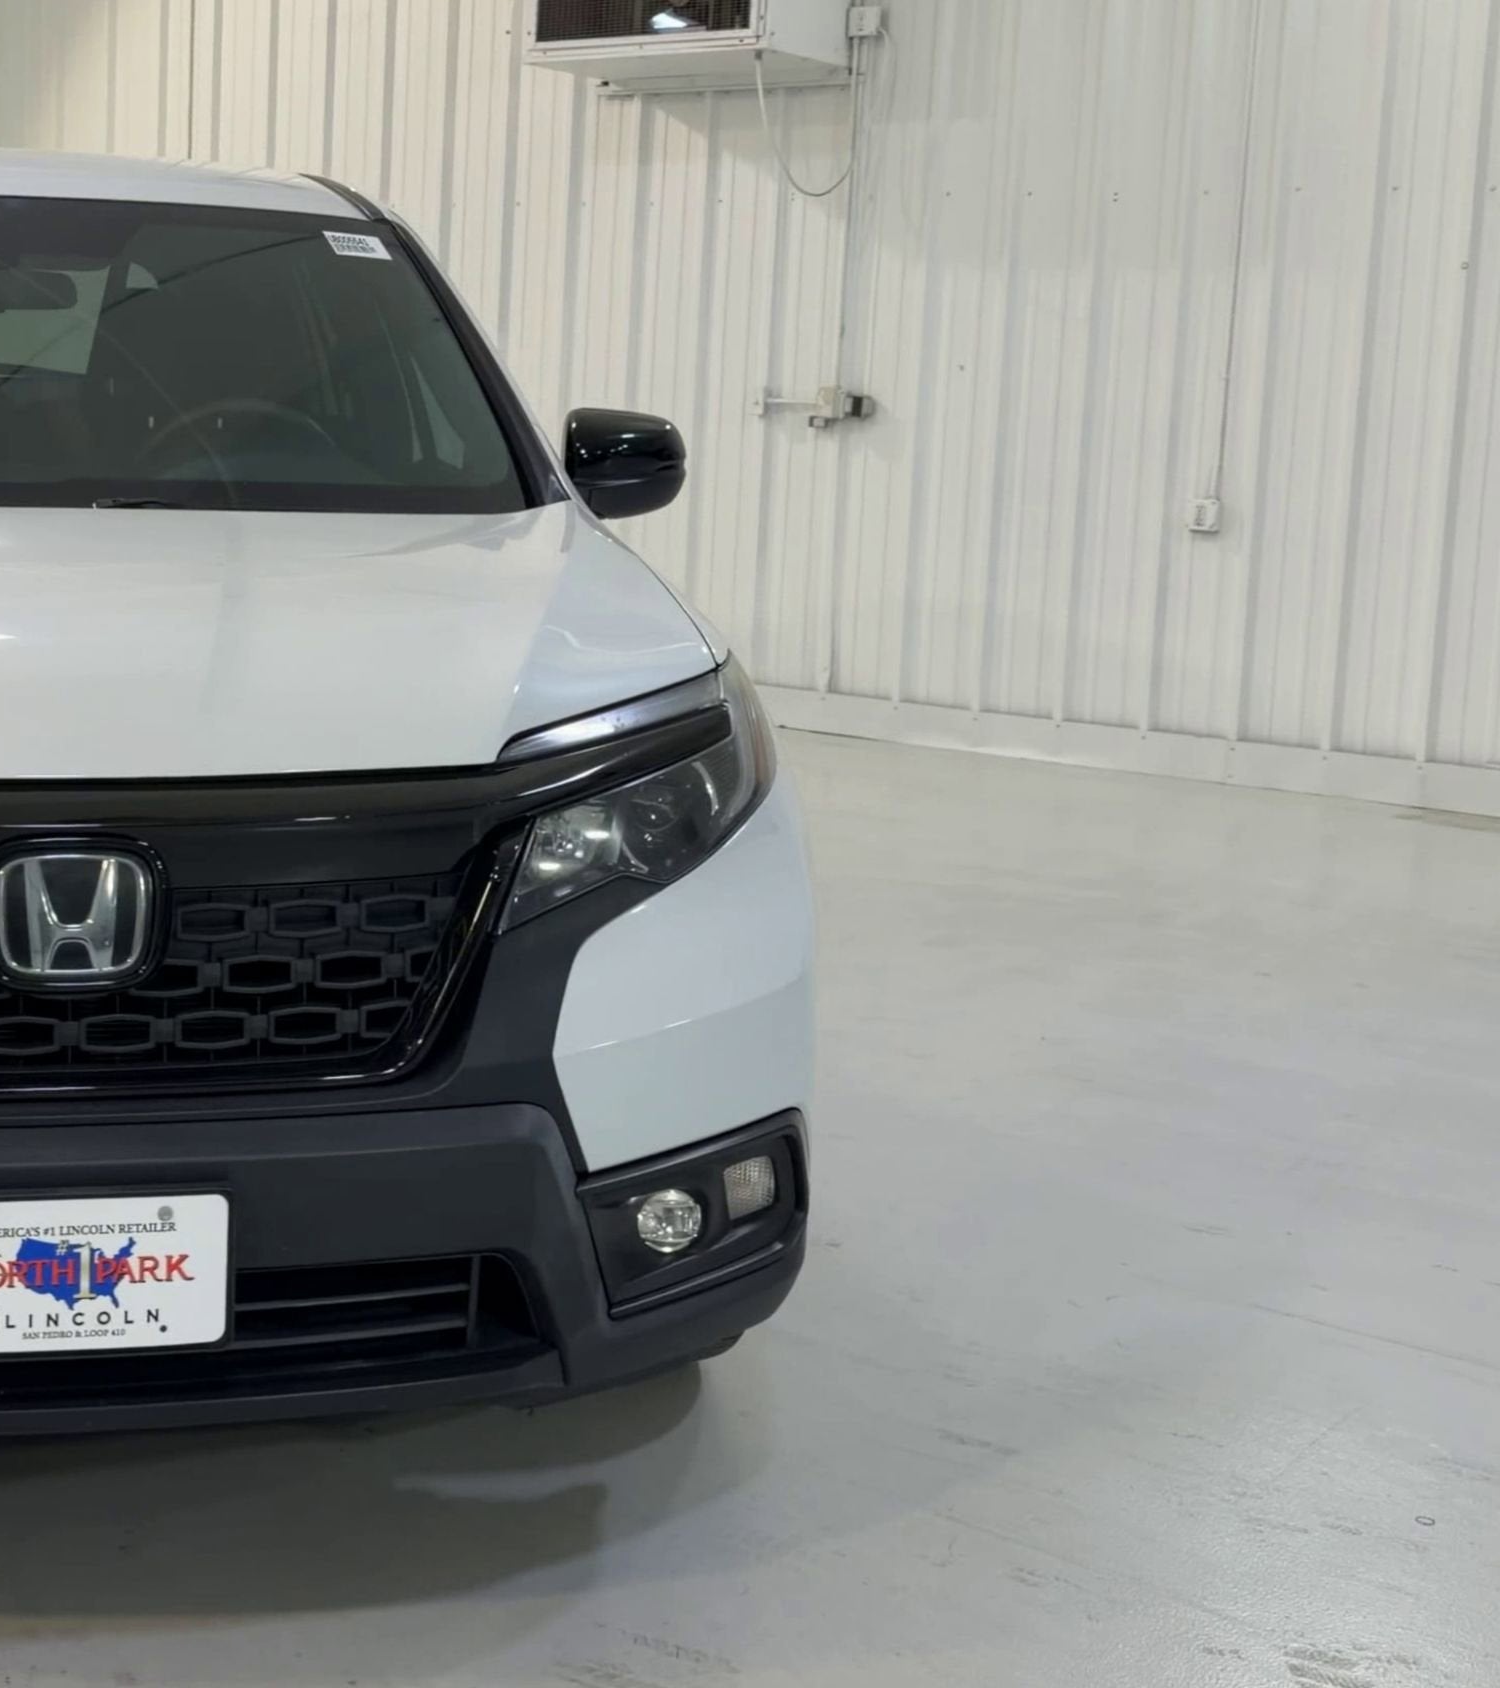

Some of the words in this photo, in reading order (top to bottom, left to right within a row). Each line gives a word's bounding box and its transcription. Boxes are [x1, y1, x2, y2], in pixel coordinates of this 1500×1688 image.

[43, 1226, 56, 1237] #1
[59, 1224, 116, 1236] LINCOLN
[118, 1222, 176, 1234] RETAILER
[95, 1254, 195, 1286] PARK
[5, 1308, 160, 1329] LINCOLN
[21, 1331, 40, 1340] SAN
[42, 1330, 73, 1340] PEDRO
[83, 1329, 110, 1338] LOOP
